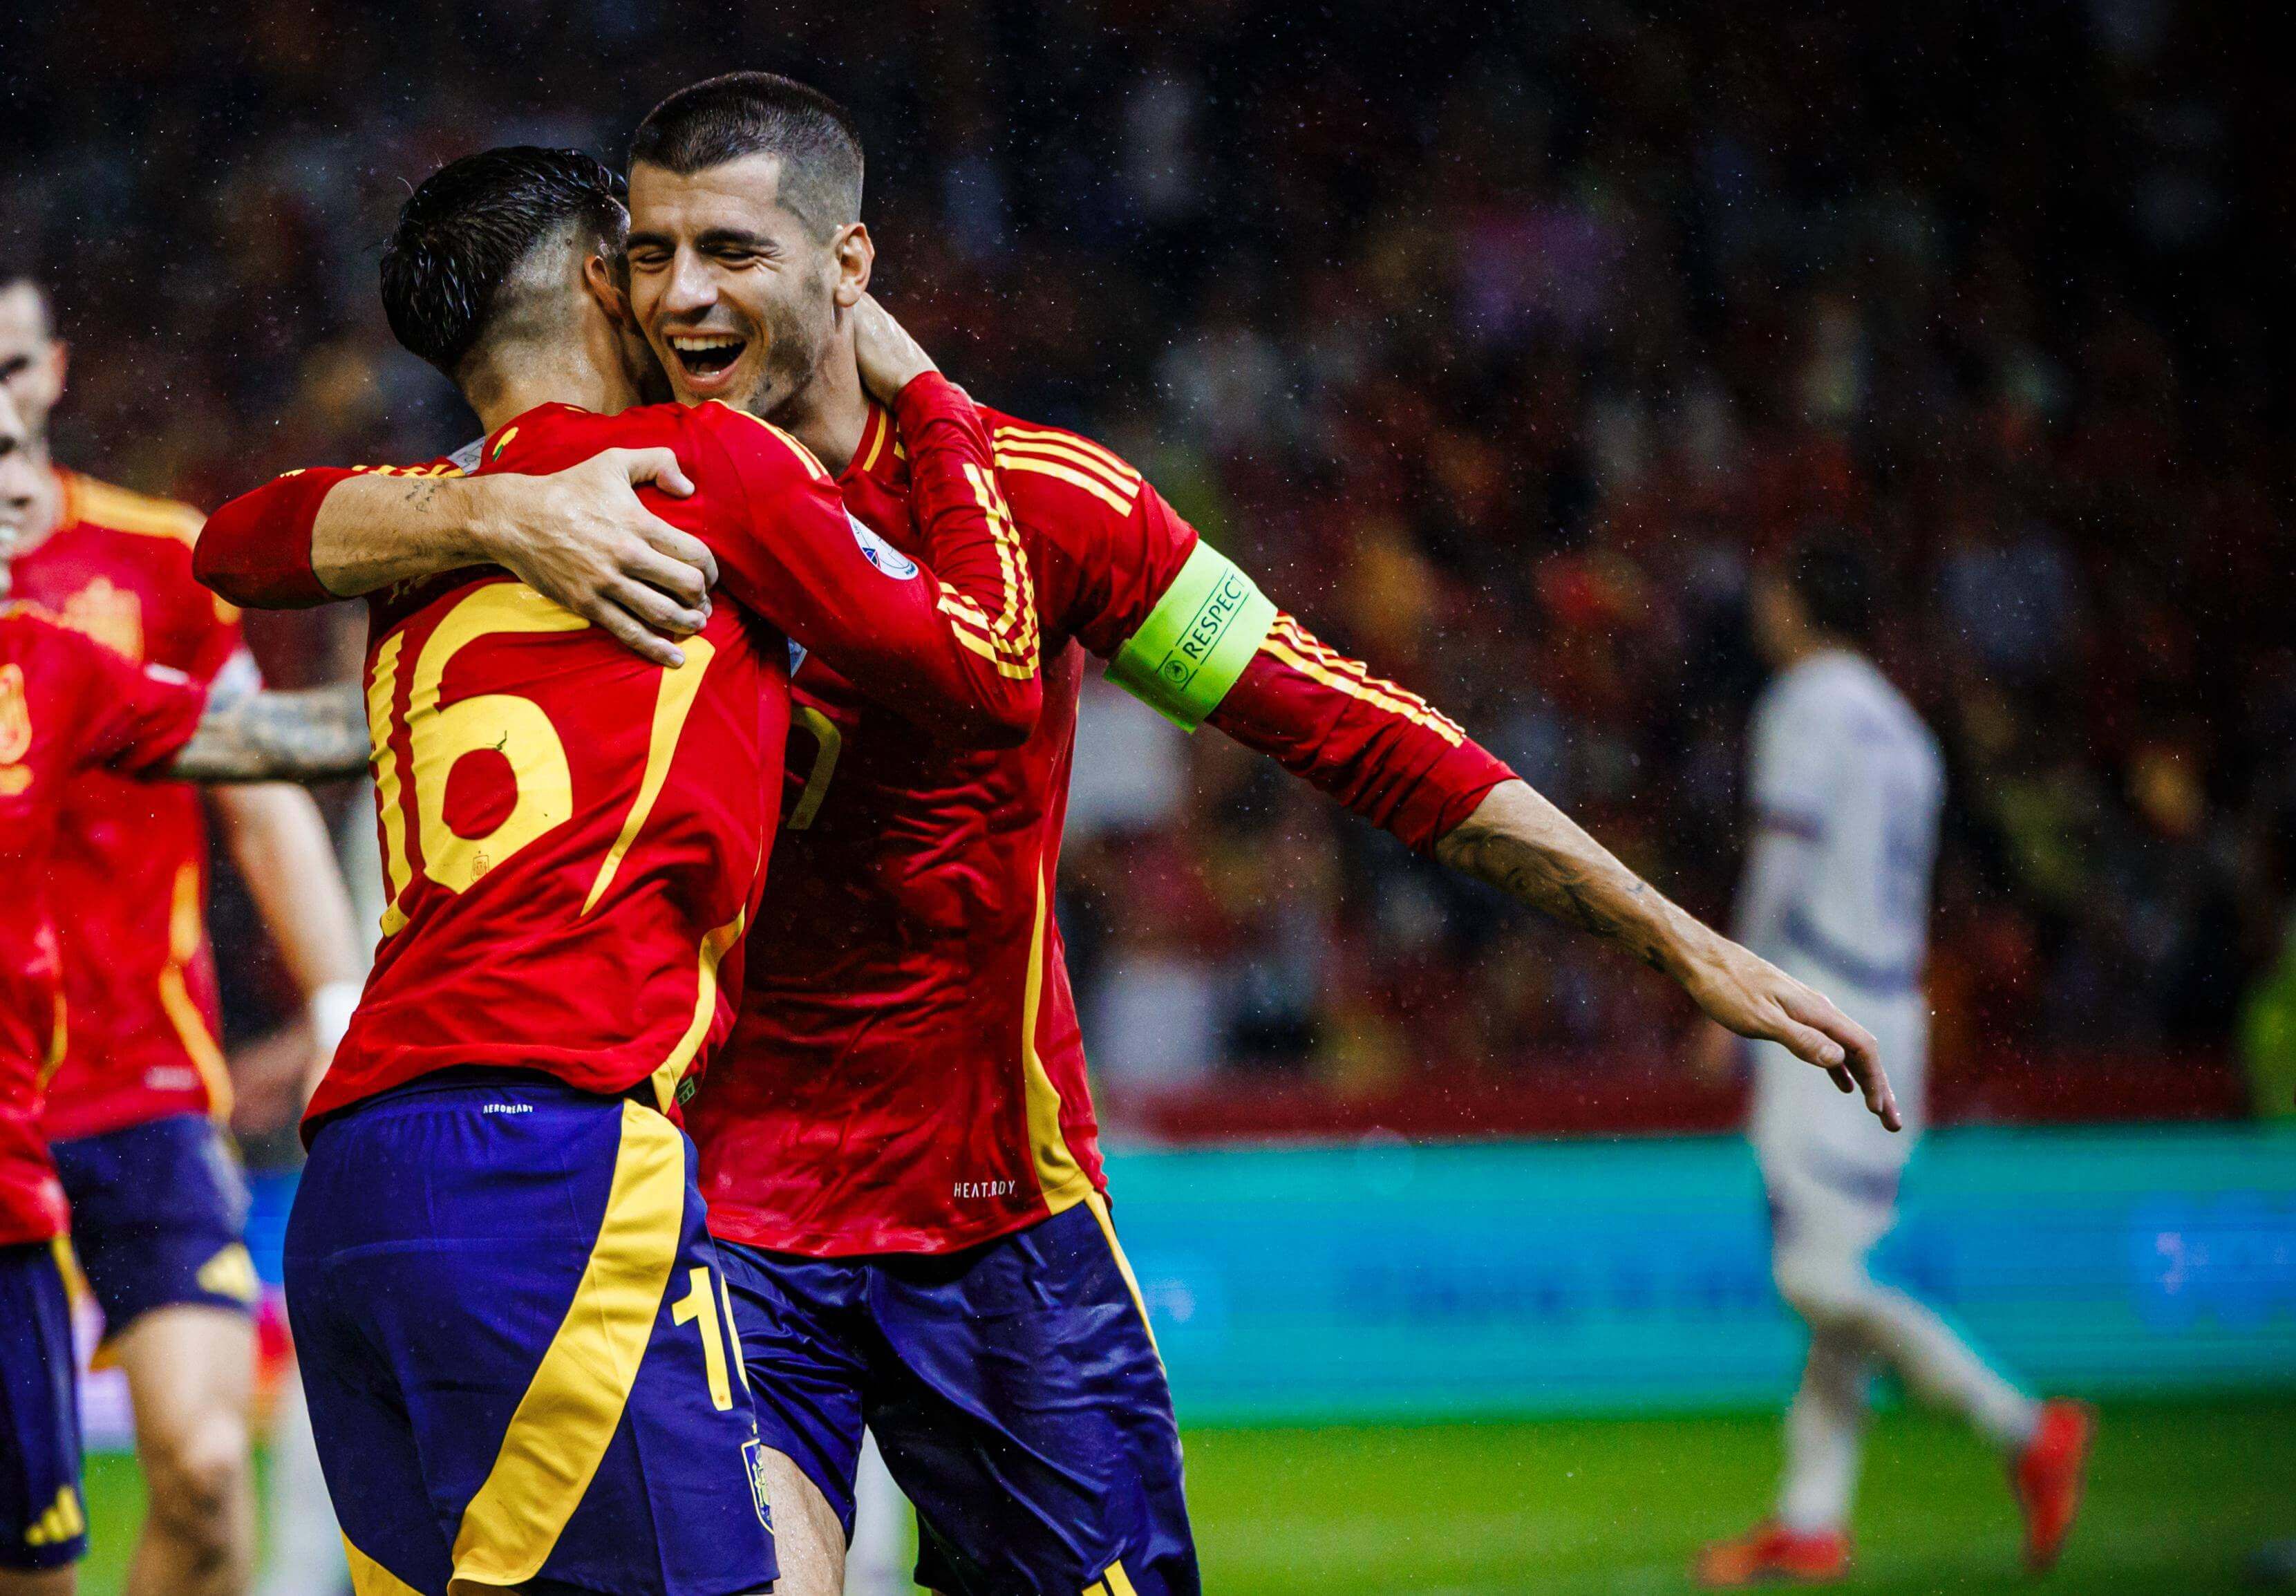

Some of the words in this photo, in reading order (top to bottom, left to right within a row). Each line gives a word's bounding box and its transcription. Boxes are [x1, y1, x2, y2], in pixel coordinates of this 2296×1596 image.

[1183, 574, 1245, 659] RESPECT
[367, 582, 590, 937] 16
[483, 1104, 533, 1114] AEROREADY
[954, 1180, 1015, 1198] HEAT.RDY
[672, 1266, 751, 1411] 1
